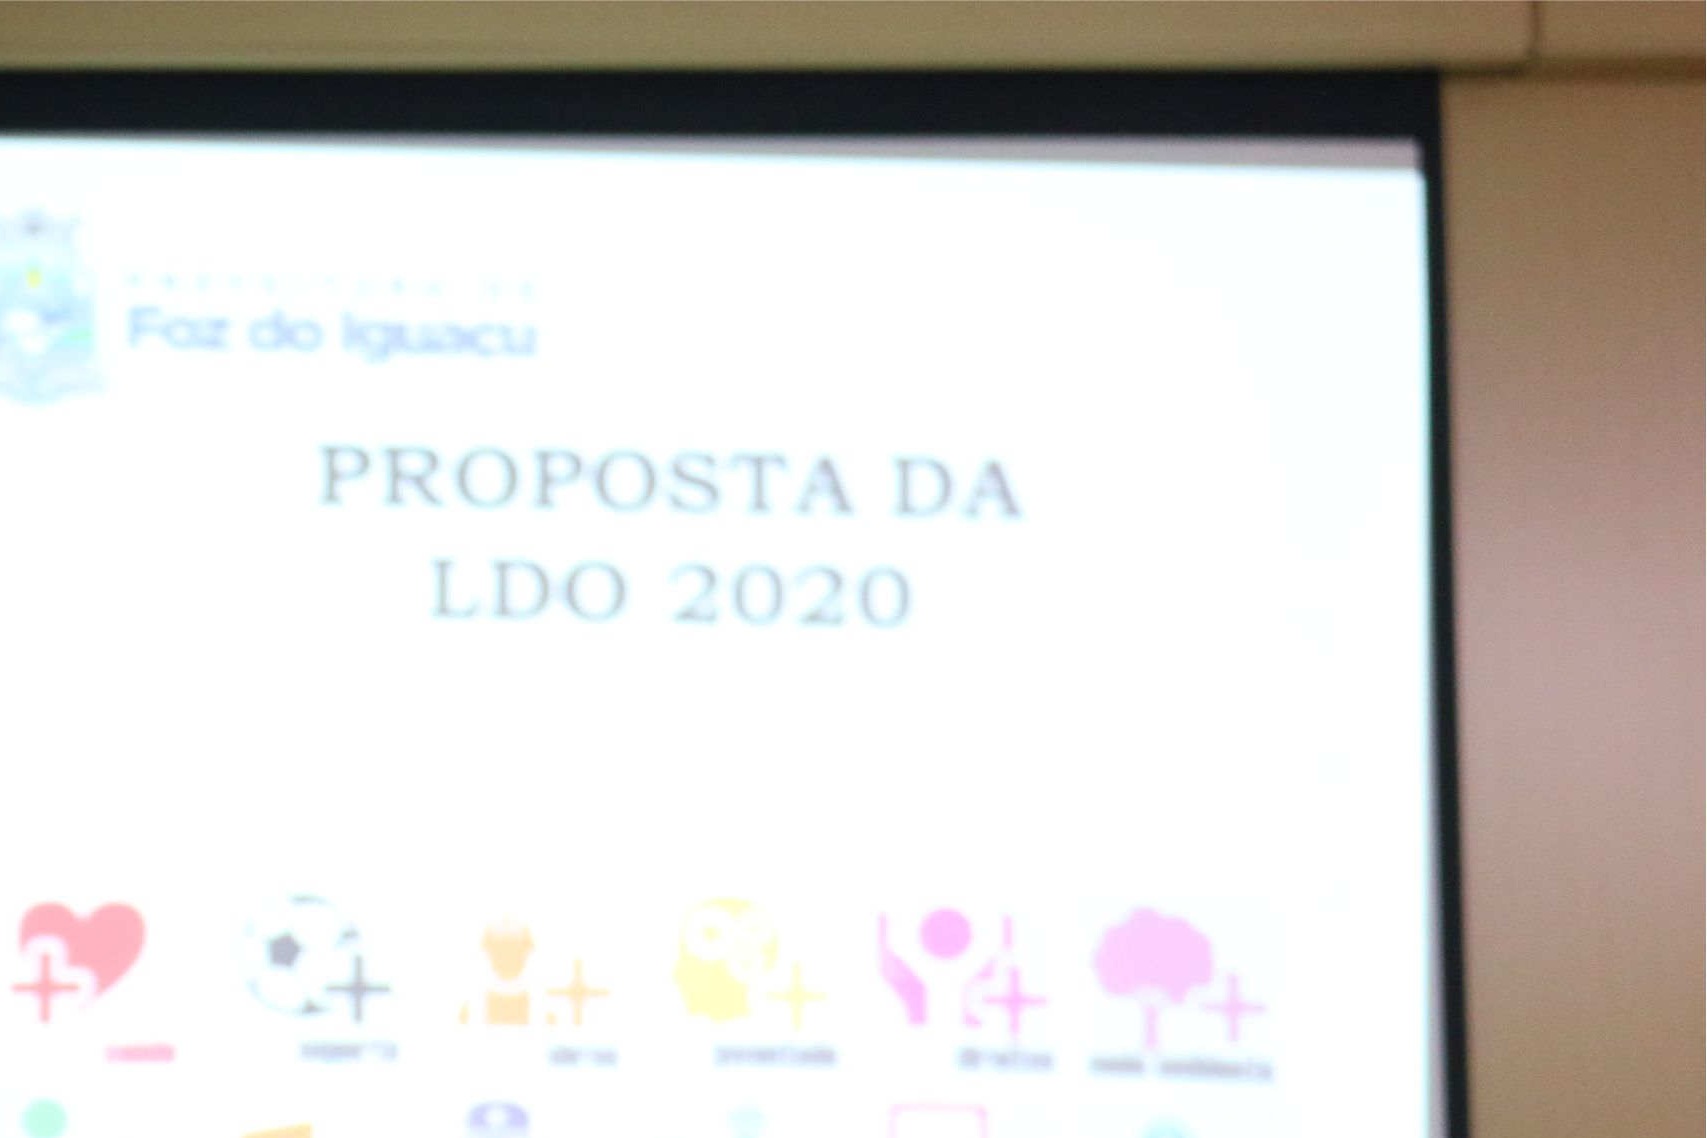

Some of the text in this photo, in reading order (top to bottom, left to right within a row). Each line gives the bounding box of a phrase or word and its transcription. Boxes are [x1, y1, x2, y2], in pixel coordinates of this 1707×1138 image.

[127, 305, 230, 349] Foz
[248, 308, 324, 352] do
[318, 443, 1025, 521] PROPOSTA DA
[430, 558, 912, 629] LDO 2020
